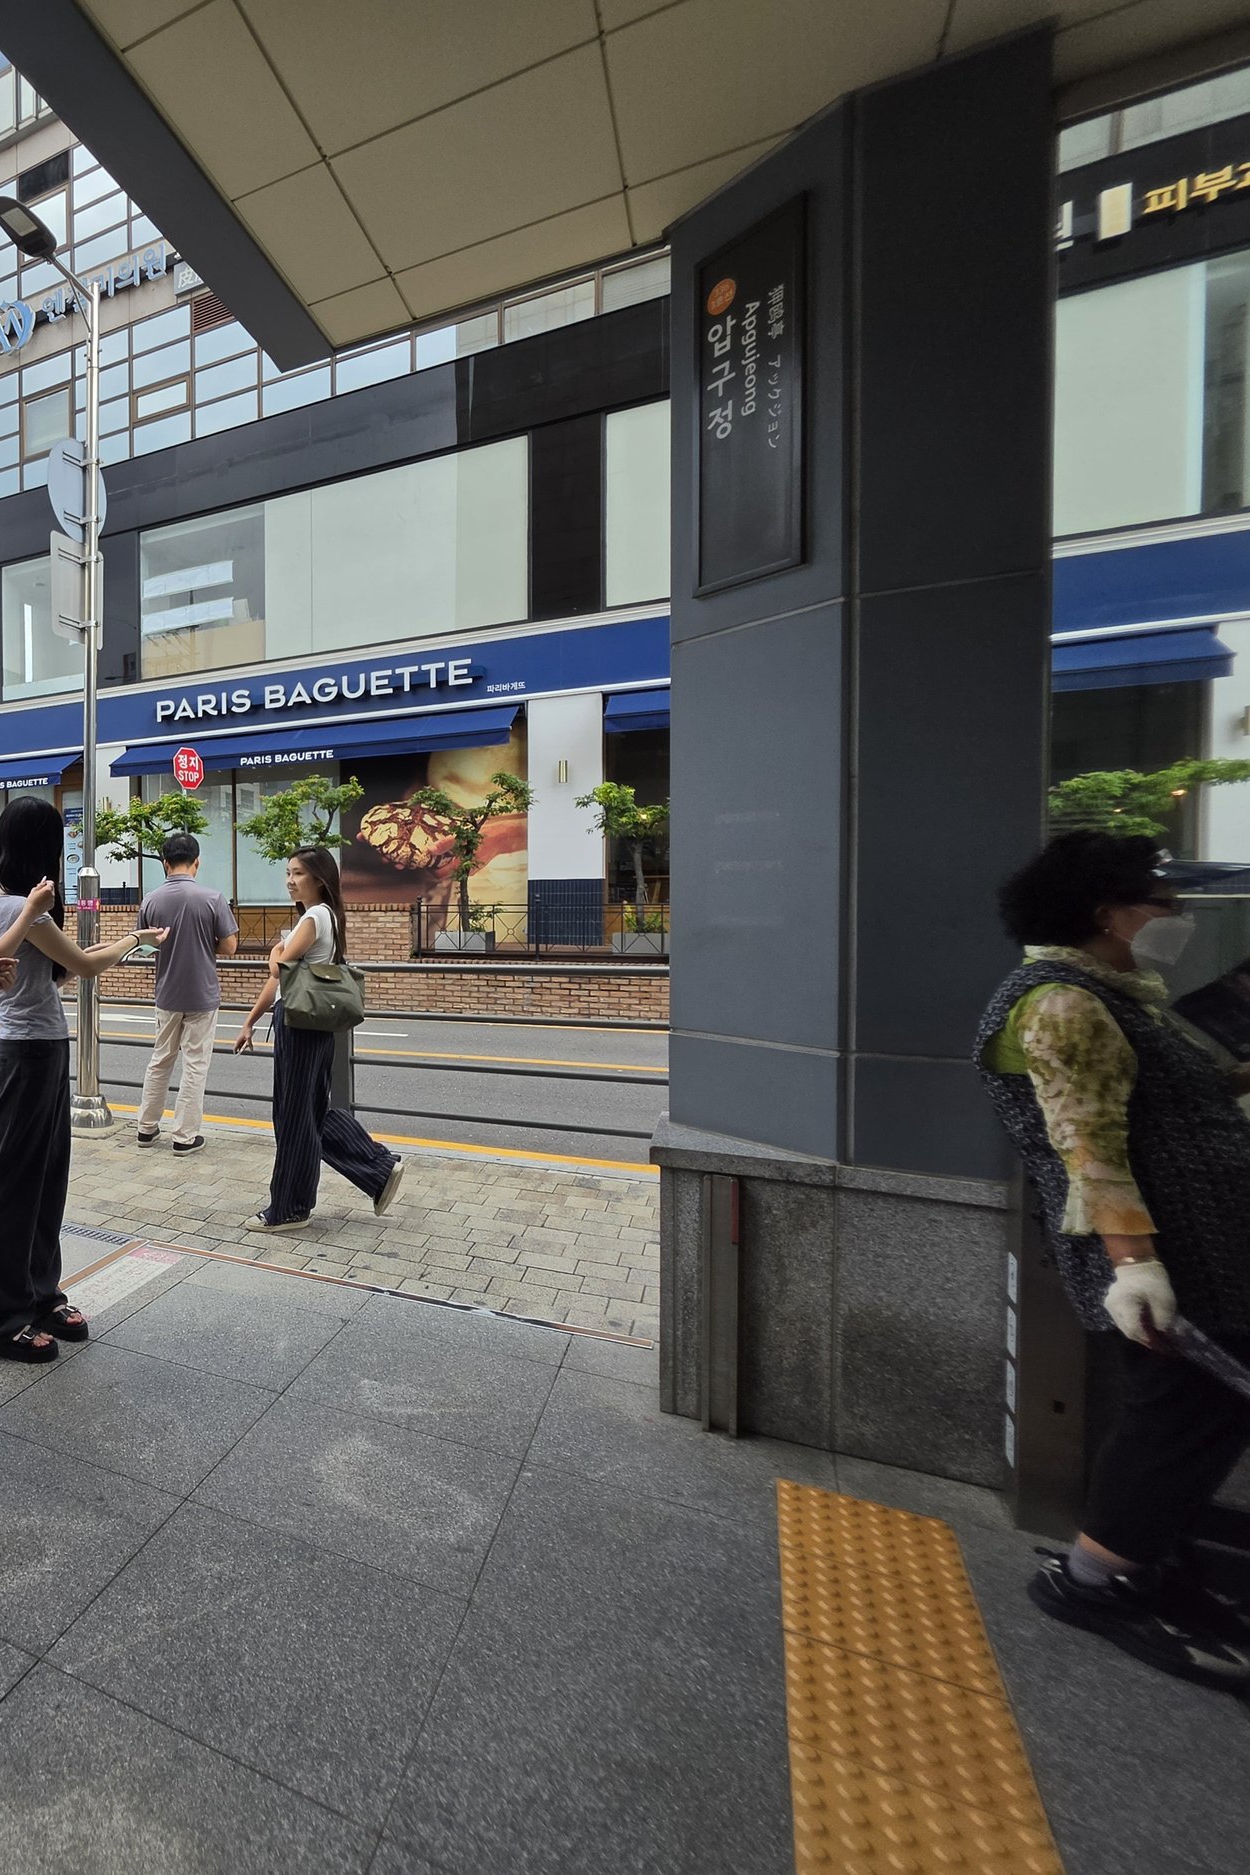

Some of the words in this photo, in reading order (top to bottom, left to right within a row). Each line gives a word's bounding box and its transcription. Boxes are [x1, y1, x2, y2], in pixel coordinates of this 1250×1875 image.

[741, 301, 760, 417] Apgujeong
[707, 315, 737, 439] 압구정
[156, 690, 252, 723] PARIS
[264, 658, 474, 710] BAGUETTE
[486, 681, 526, 693] 파리바게뜨
[177, 754, 199, 770] 정지
[240, 755, 272, 766] PARIS
[275, 750, 334, 763] BAGUETTE
[6, 778, 48, 788] BAGUETTE
[178, 770, 199, 783] STOP
